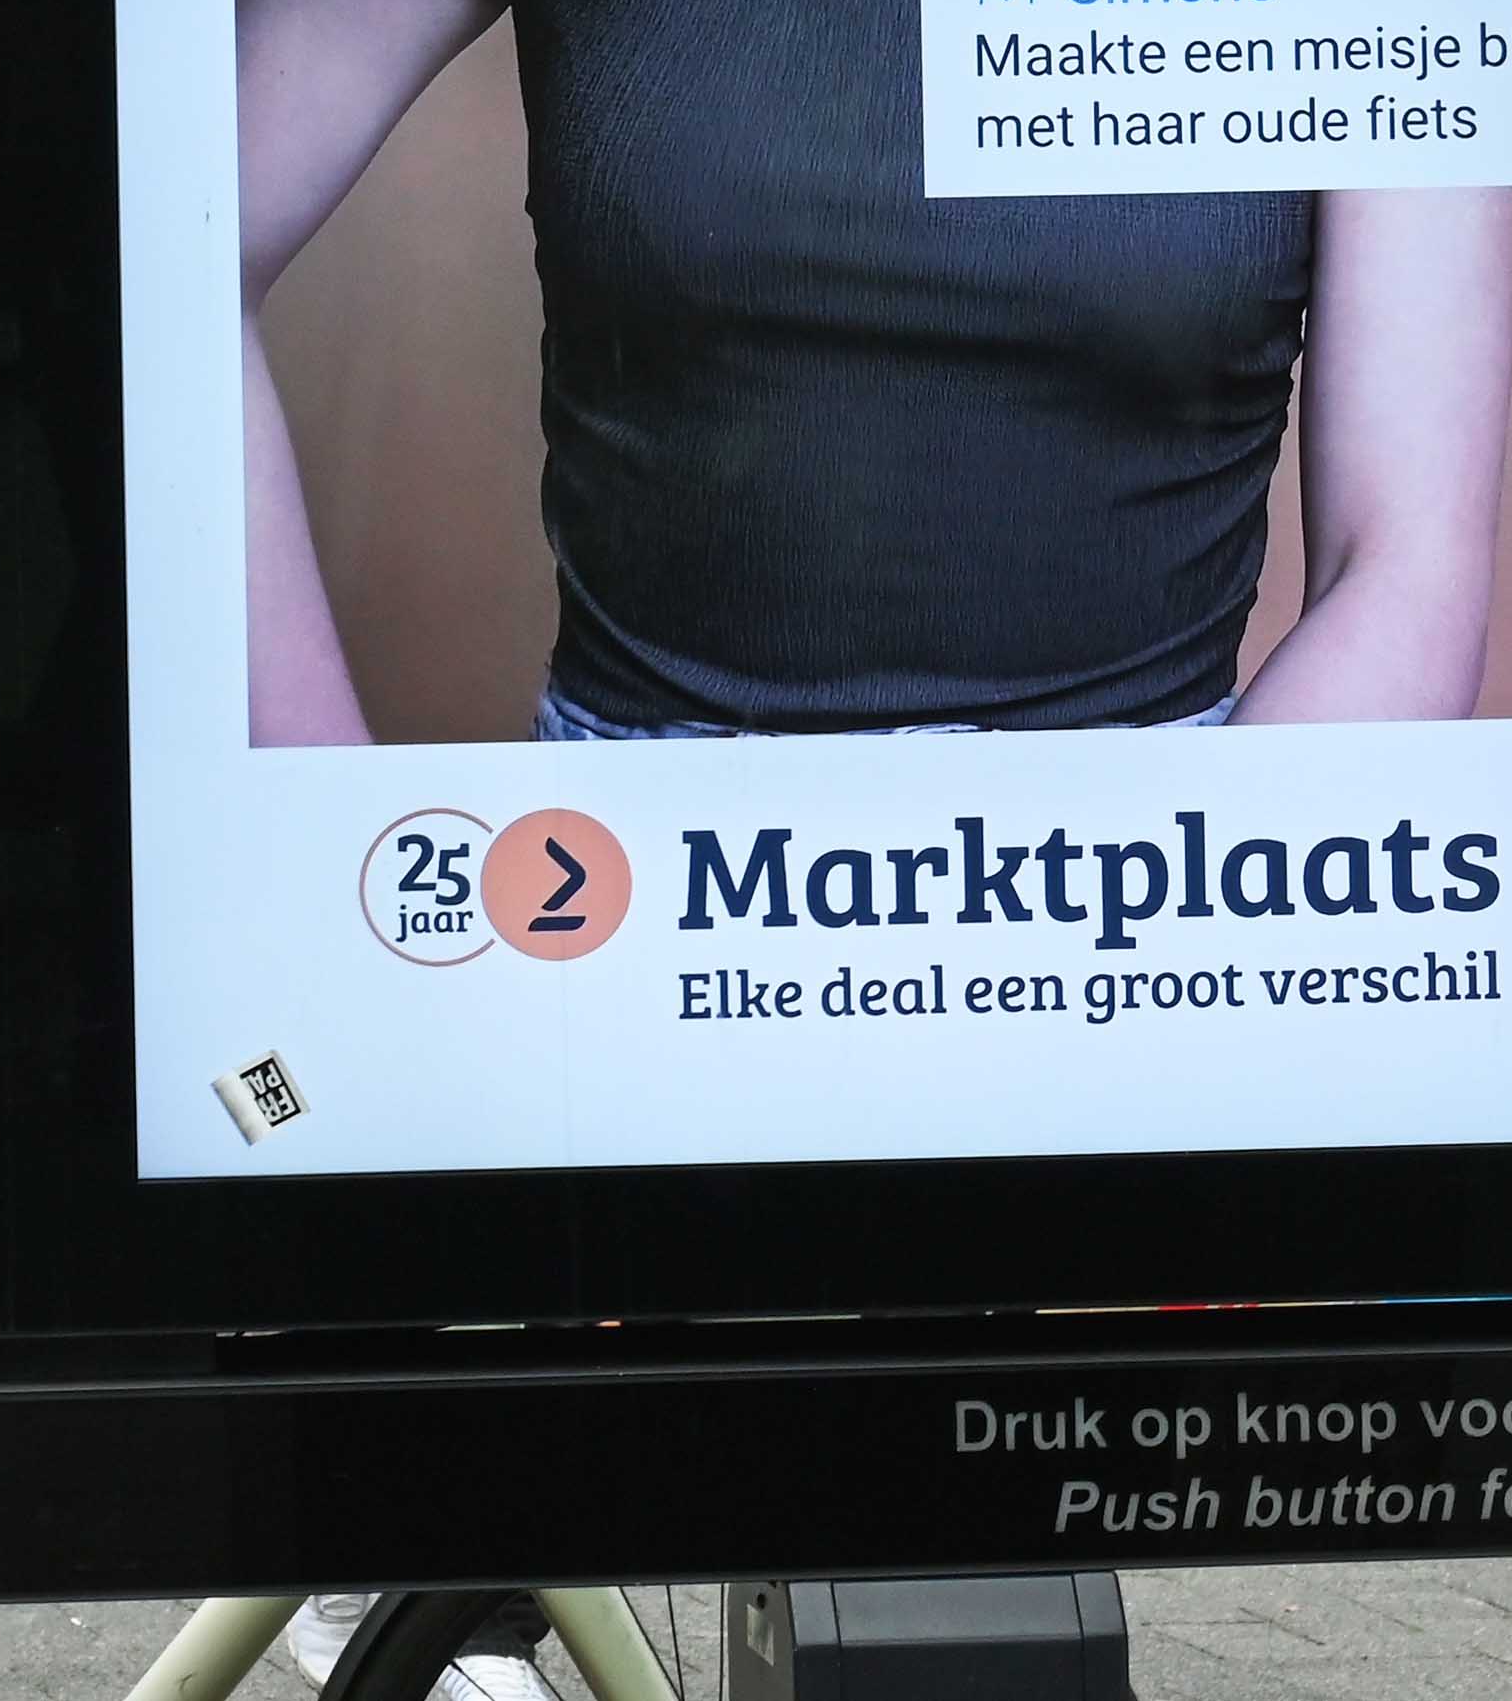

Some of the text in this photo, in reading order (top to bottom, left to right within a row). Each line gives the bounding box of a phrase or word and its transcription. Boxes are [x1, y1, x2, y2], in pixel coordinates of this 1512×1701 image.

[976, 29, 1166, 77] Maakte
[1184, 39, 1274, 74] een
[1294, 25, 1461, 81] meisje
[977, 94, 1477, 148] met haar oude fiets
[397, 834, 471, 906] 25
[678, 811, 1500, 950] Marktplaats
[394, 903, 474, 943] jaar
[678, 950, 1501, 1025] Elke deal een groot verschil
[956, 1398, 1107, 1452] Druk
[1132, 1407, 1211, 1460] op
[1237, 1393, 1396, 1453] knop
[1055, 1477, 1220, 1532] Push
[1244, 1472, 1455, 1527] button
